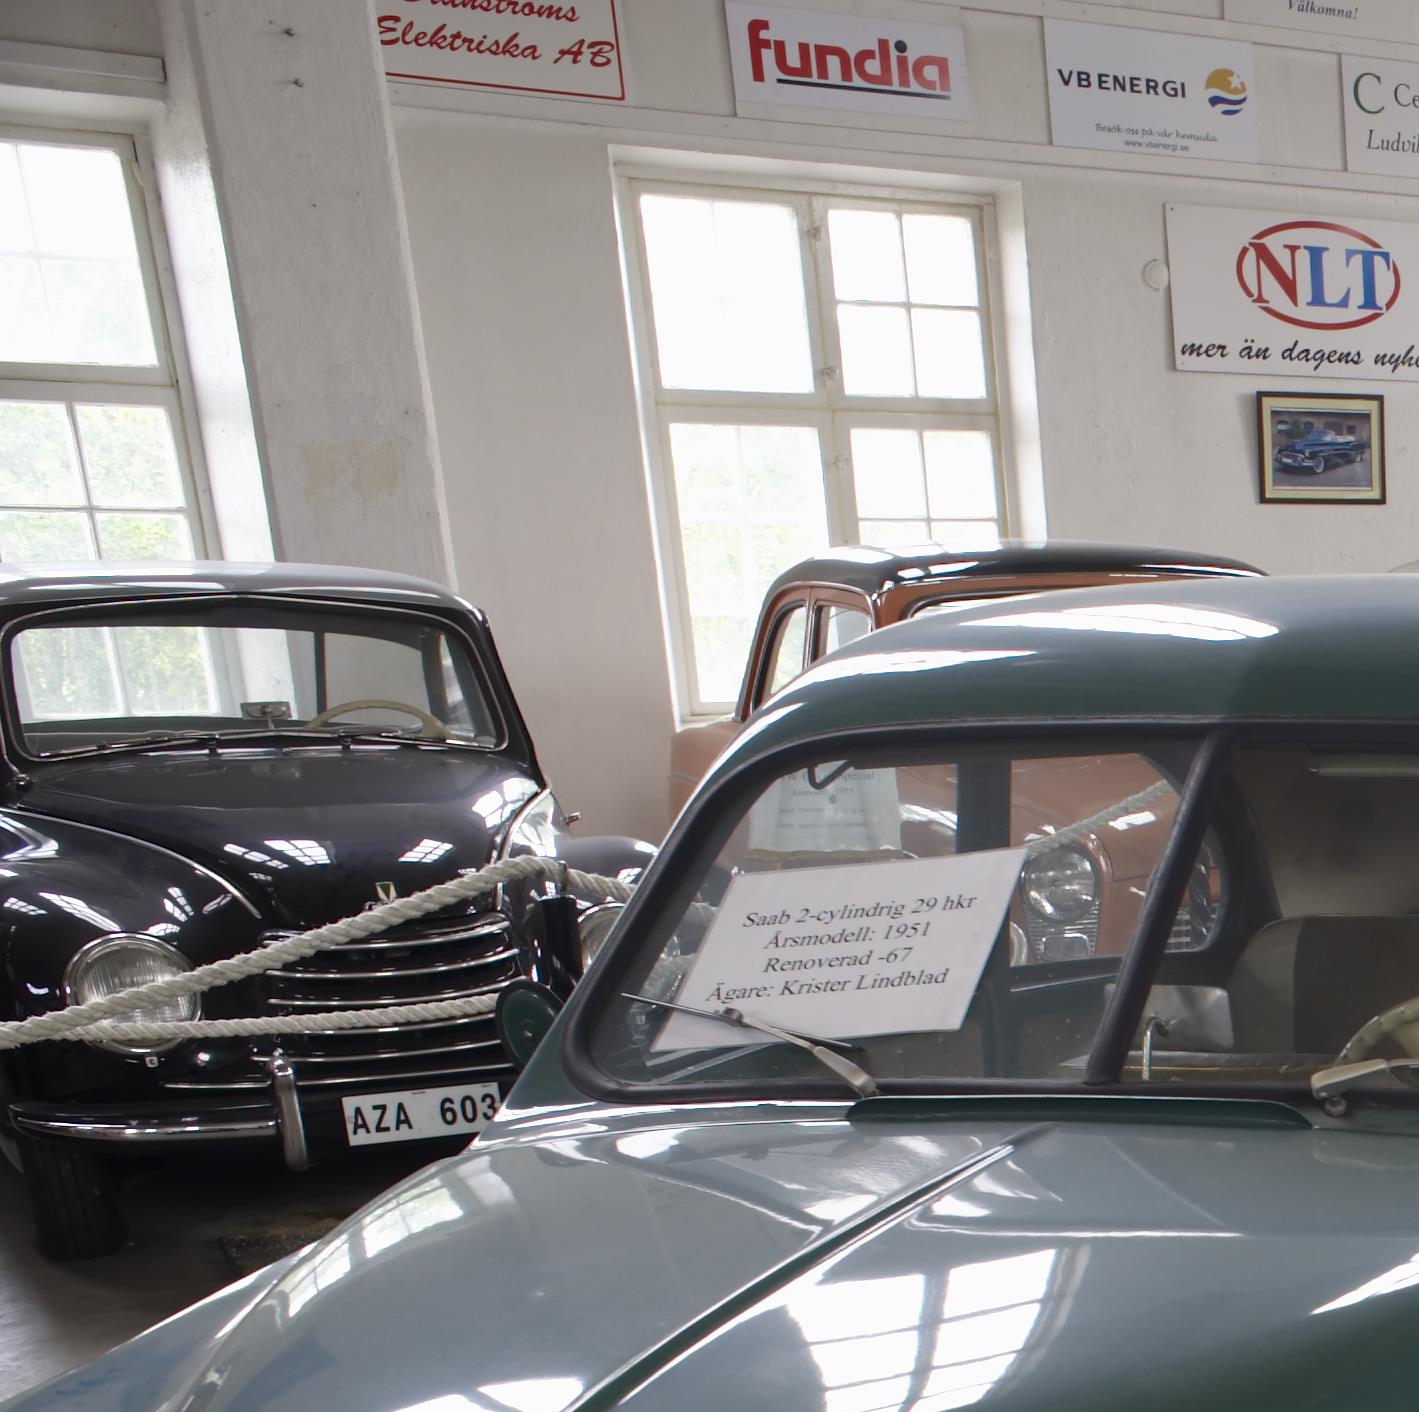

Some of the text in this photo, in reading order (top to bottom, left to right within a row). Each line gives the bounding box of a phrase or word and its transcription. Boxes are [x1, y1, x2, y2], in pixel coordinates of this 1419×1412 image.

[378, 15, 616, 67] Elektriska AB
[748, 19, 950, 92] fundia
[1248, 241, 1391, 311] NLT
[1180, 339, 1229, 359] mer
[1239, 338, 1272, 360] än
[1281, 340, 1364, 371] dagens
[742, 893, 978, 928] Saab 2-cylindrig 29 hkr
[764, 921, 931, 950] Årsmodell: 1951
[764, 947, 913, 973] Renoverad -67
[706, 968, 949, 1005] Ägare: Krister Lindblad
[353, 1093, 498, 1136] AZA 603
